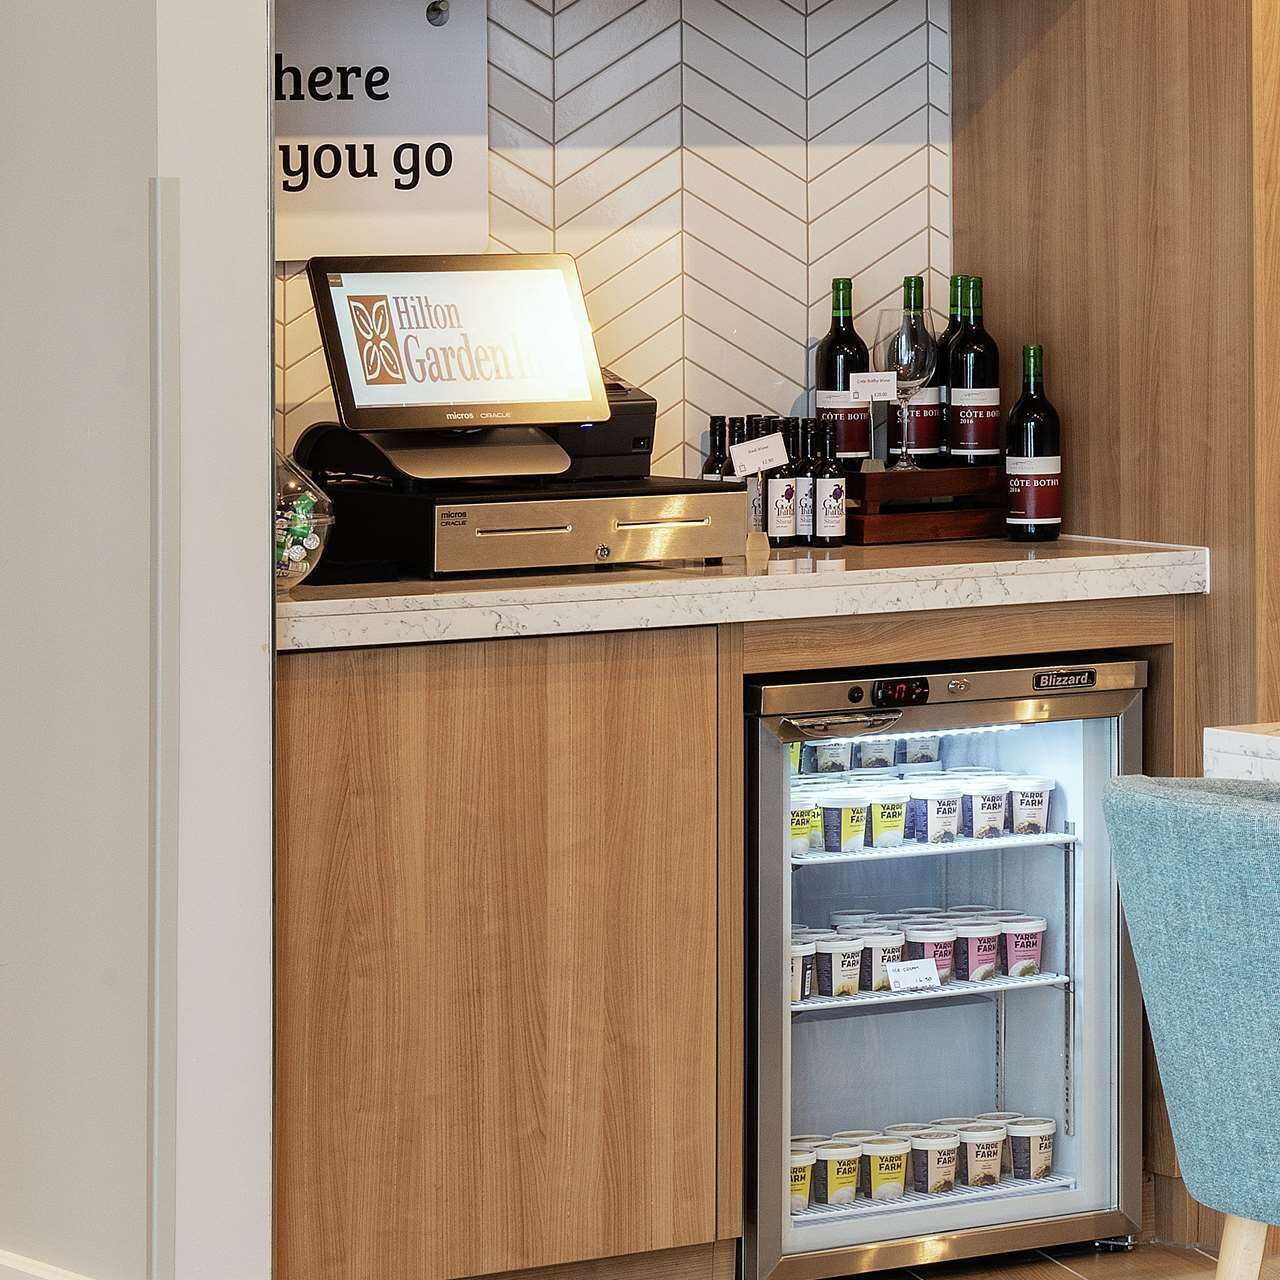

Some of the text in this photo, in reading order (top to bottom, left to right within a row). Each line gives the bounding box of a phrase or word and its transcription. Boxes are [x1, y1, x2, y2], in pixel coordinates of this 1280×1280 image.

[275, 54, 391, 101] here
[279, 141, 454, 192] you go
[393, 296, 463, 330] Hilton
[403, 333, 513, 384] Garden
[446, 412, 474, 420] micros
[822, 412, 845, 420] CÔTE
[960, 409, 984, 418] CÔTE
[1010, 479, 1031, 487] CÔTE
[440, 511, 468, 519] micros
[1040, 673, 1088, 687] Blizzard
[981, 802, 1002, 811] FARM
[881, 811, 902, 819] FARM
[936, 807, 958, 815] FARM
[1014, 940, 1038, 948] FARM
[975, 1151, 999, 1159] FARM
[937, 1157, 956, 1165] FARM
[879, 1163, 902, 1171] FARM
